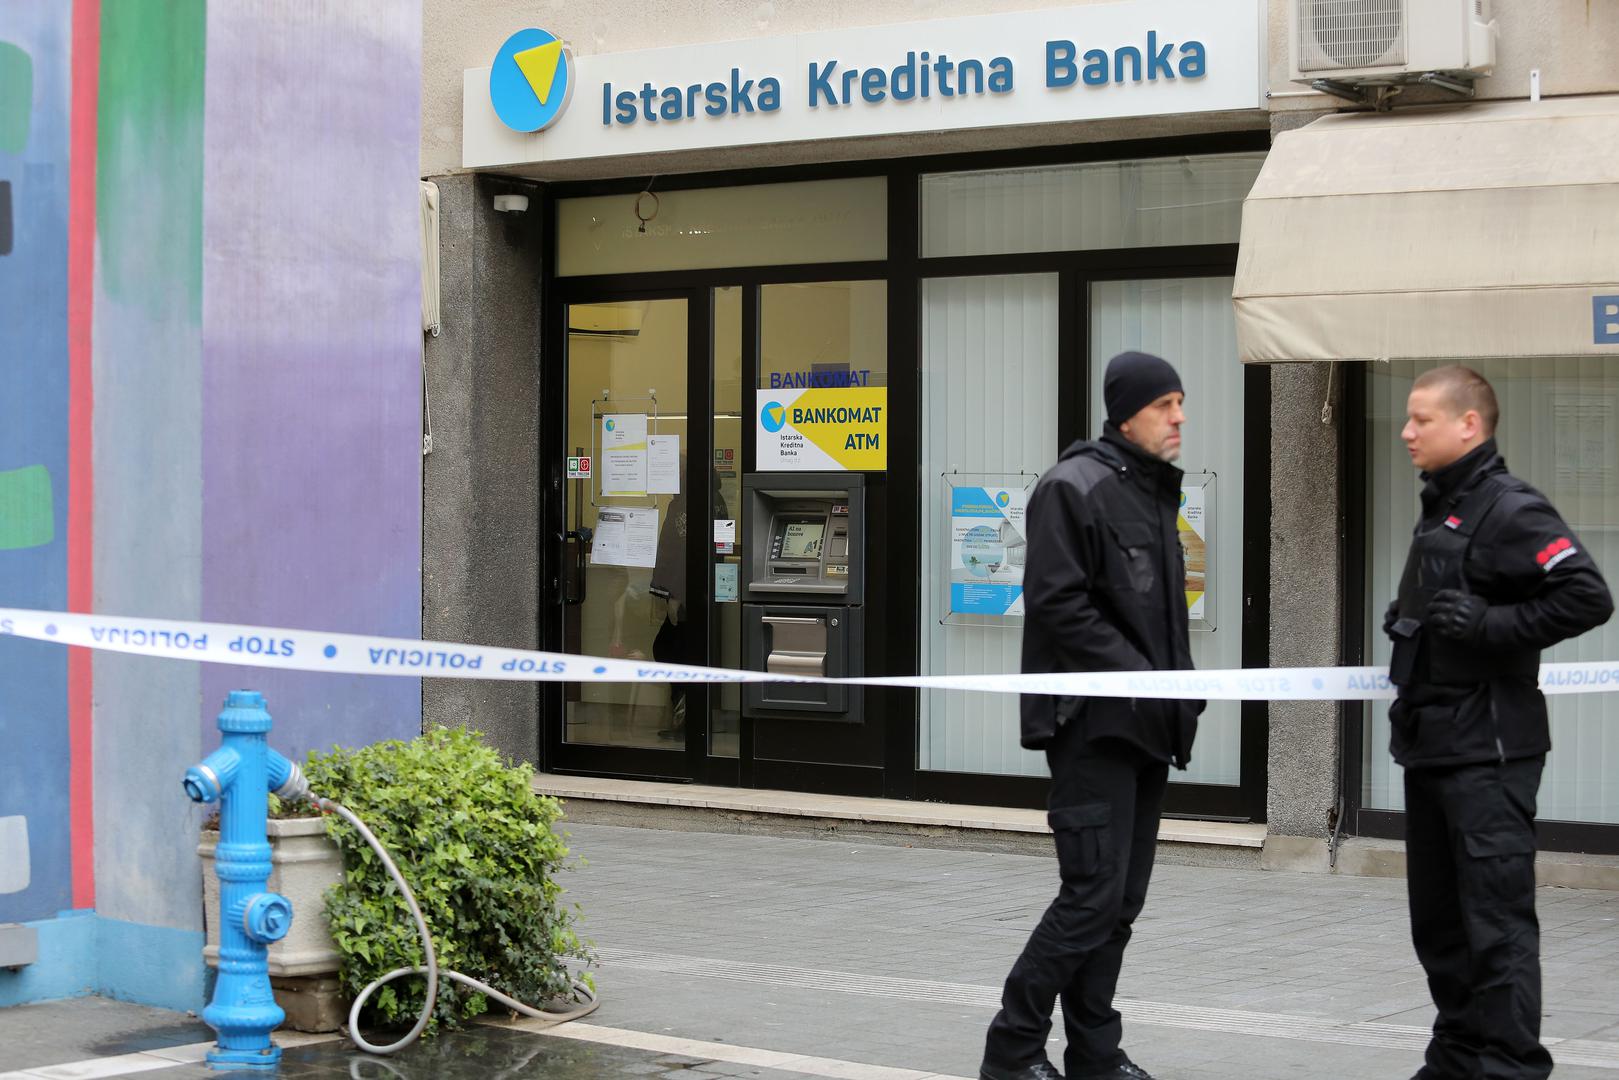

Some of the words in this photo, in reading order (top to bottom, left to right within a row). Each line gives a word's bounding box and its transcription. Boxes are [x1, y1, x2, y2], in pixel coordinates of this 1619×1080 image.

[602, 67, 781, 126] Istarska
[808, 50, 1014, 107] Kreditna
[1044, 30, 1207, 88] Banka
[770, 370, 870, 389] BANKOMAT
[793, 407, 882, 424] BANKOMAT
[844, 433, 880, 450] ATM
[89, 626, 209, 651] POLICIJA
[228, 636, 295, 657] STOP
[368, 648, 483, 670] POLICIJA
[500, 657, 567, 675] STOP
